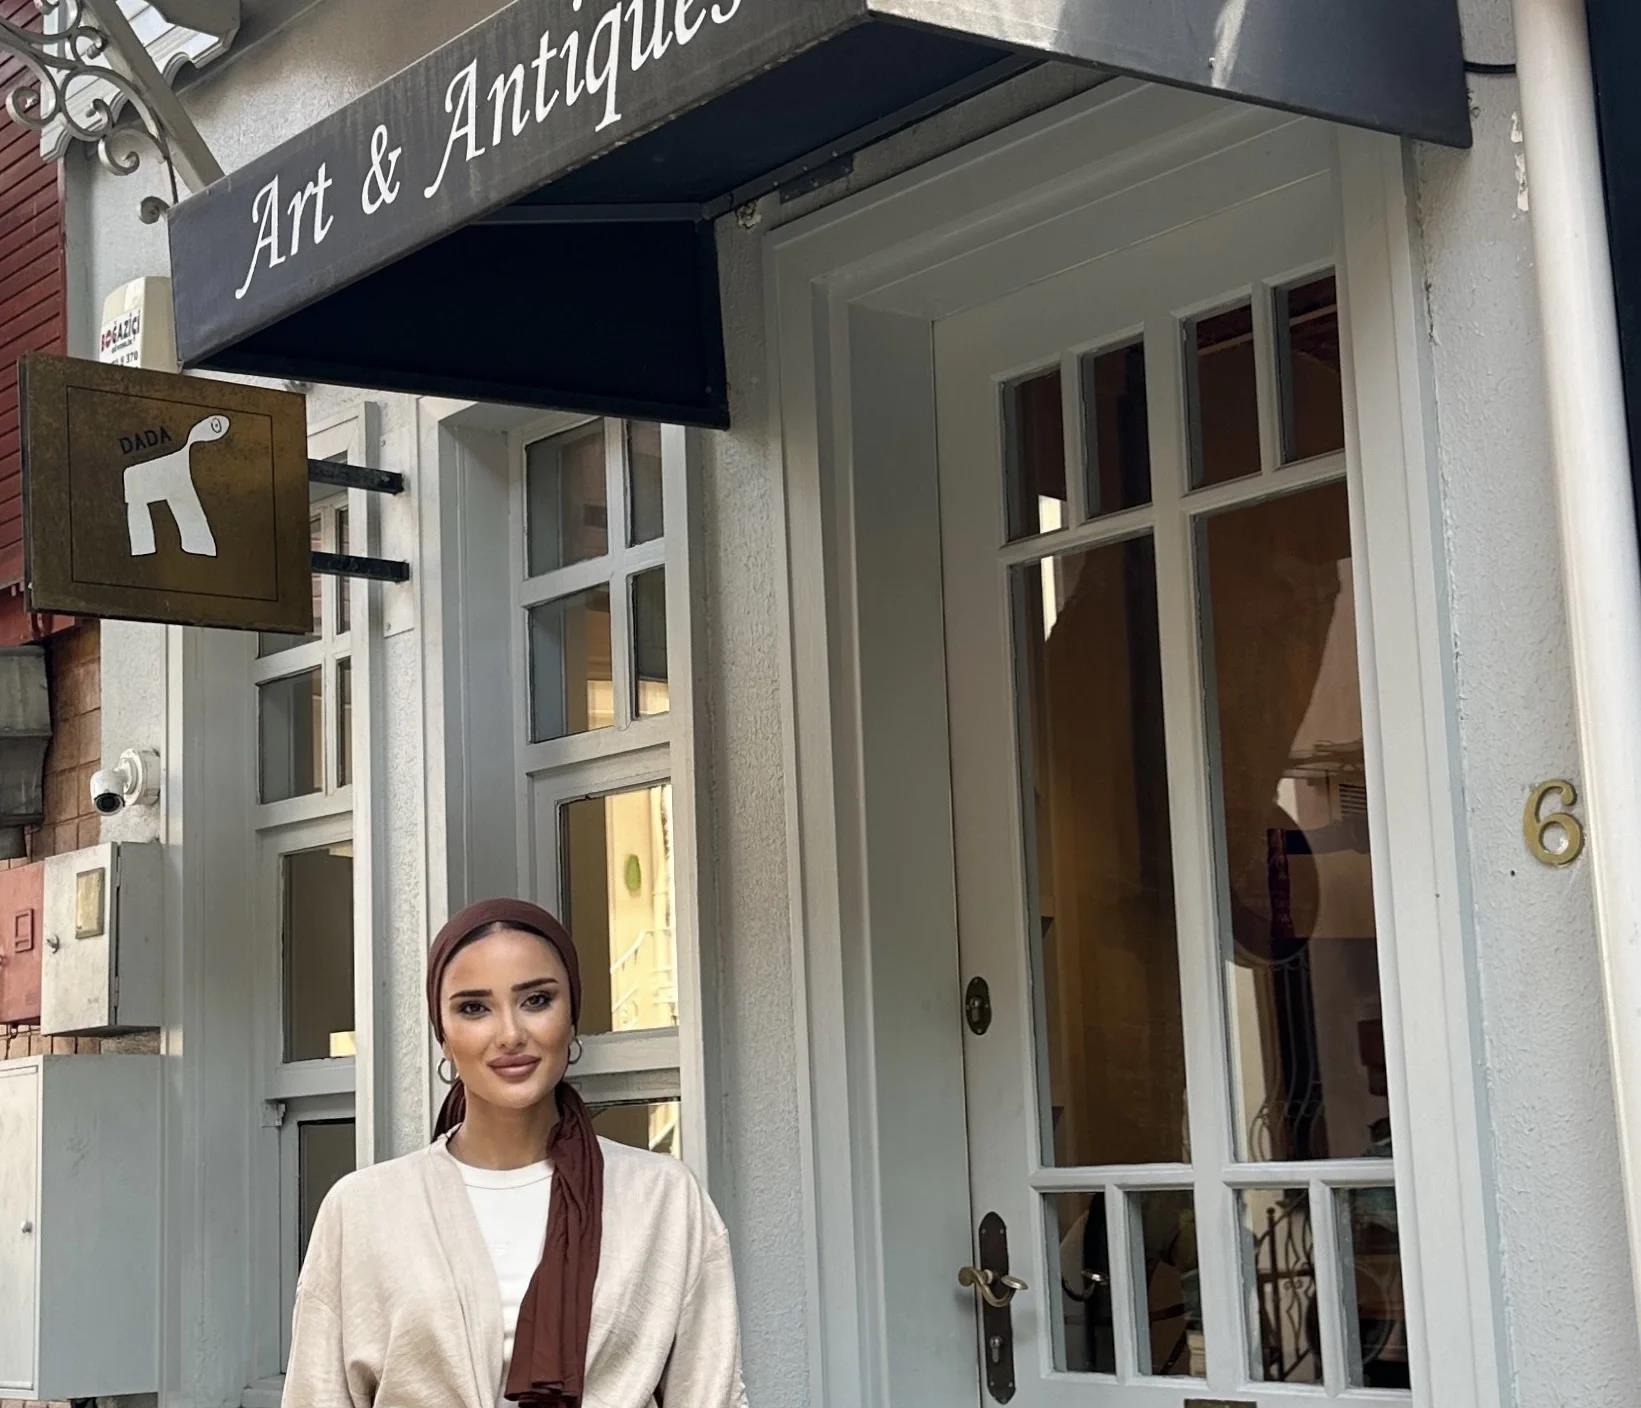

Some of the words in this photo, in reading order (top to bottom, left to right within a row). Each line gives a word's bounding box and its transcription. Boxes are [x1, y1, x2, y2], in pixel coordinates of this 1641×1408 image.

[234, 161, 334, 300] Art
[361, 124, 402, 215] &
[118, 425, 172, 455] DADA
[1523, 779, 1585, 866] 6
